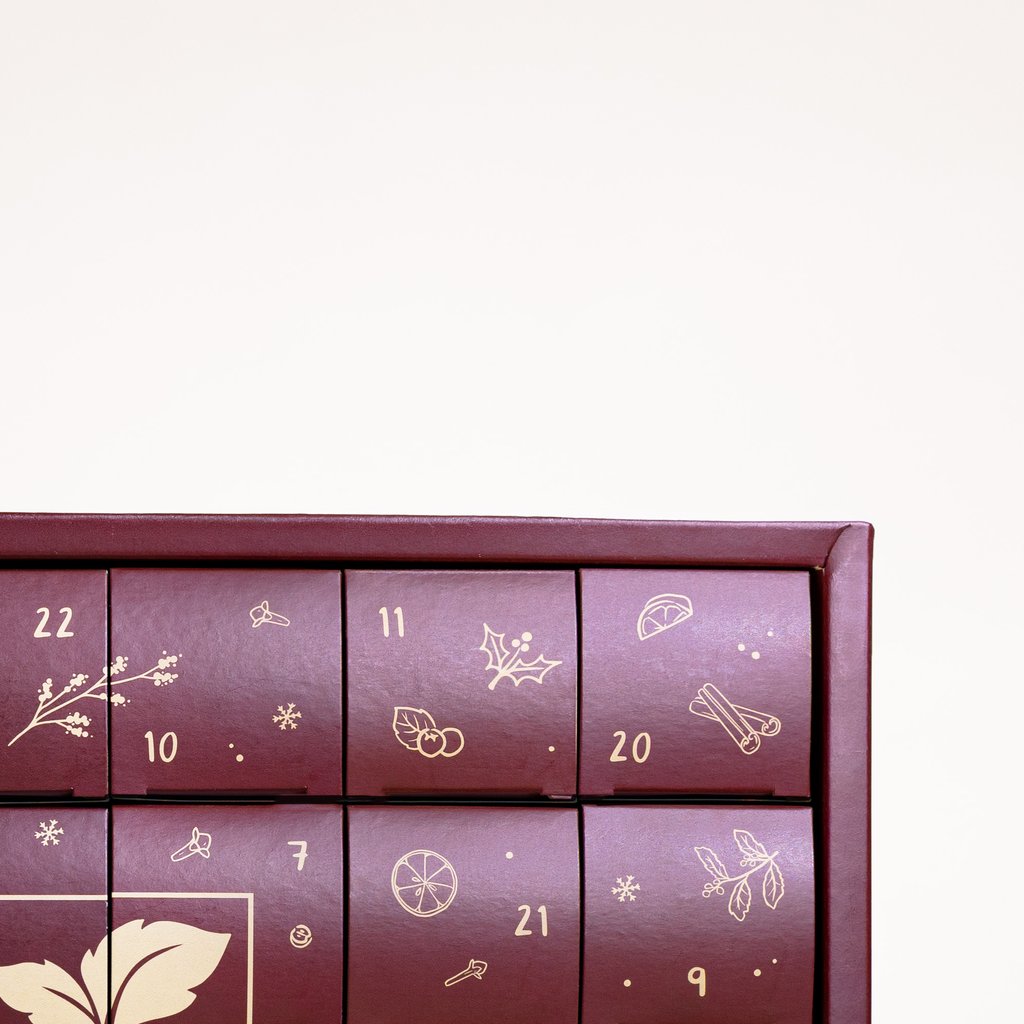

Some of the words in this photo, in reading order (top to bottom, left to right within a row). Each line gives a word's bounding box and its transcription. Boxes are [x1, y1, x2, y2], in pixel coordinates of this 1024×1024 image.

[33, 606, 75, 639] 22
[378, 606, 405, 638] 11
[144, 730, 178, 763] 10
[609, 730, 651, 764] 20
[287, 840, 309, 872] 7
[514, 904, 548, 937] 21
[687, 966, 706, 997] 9
